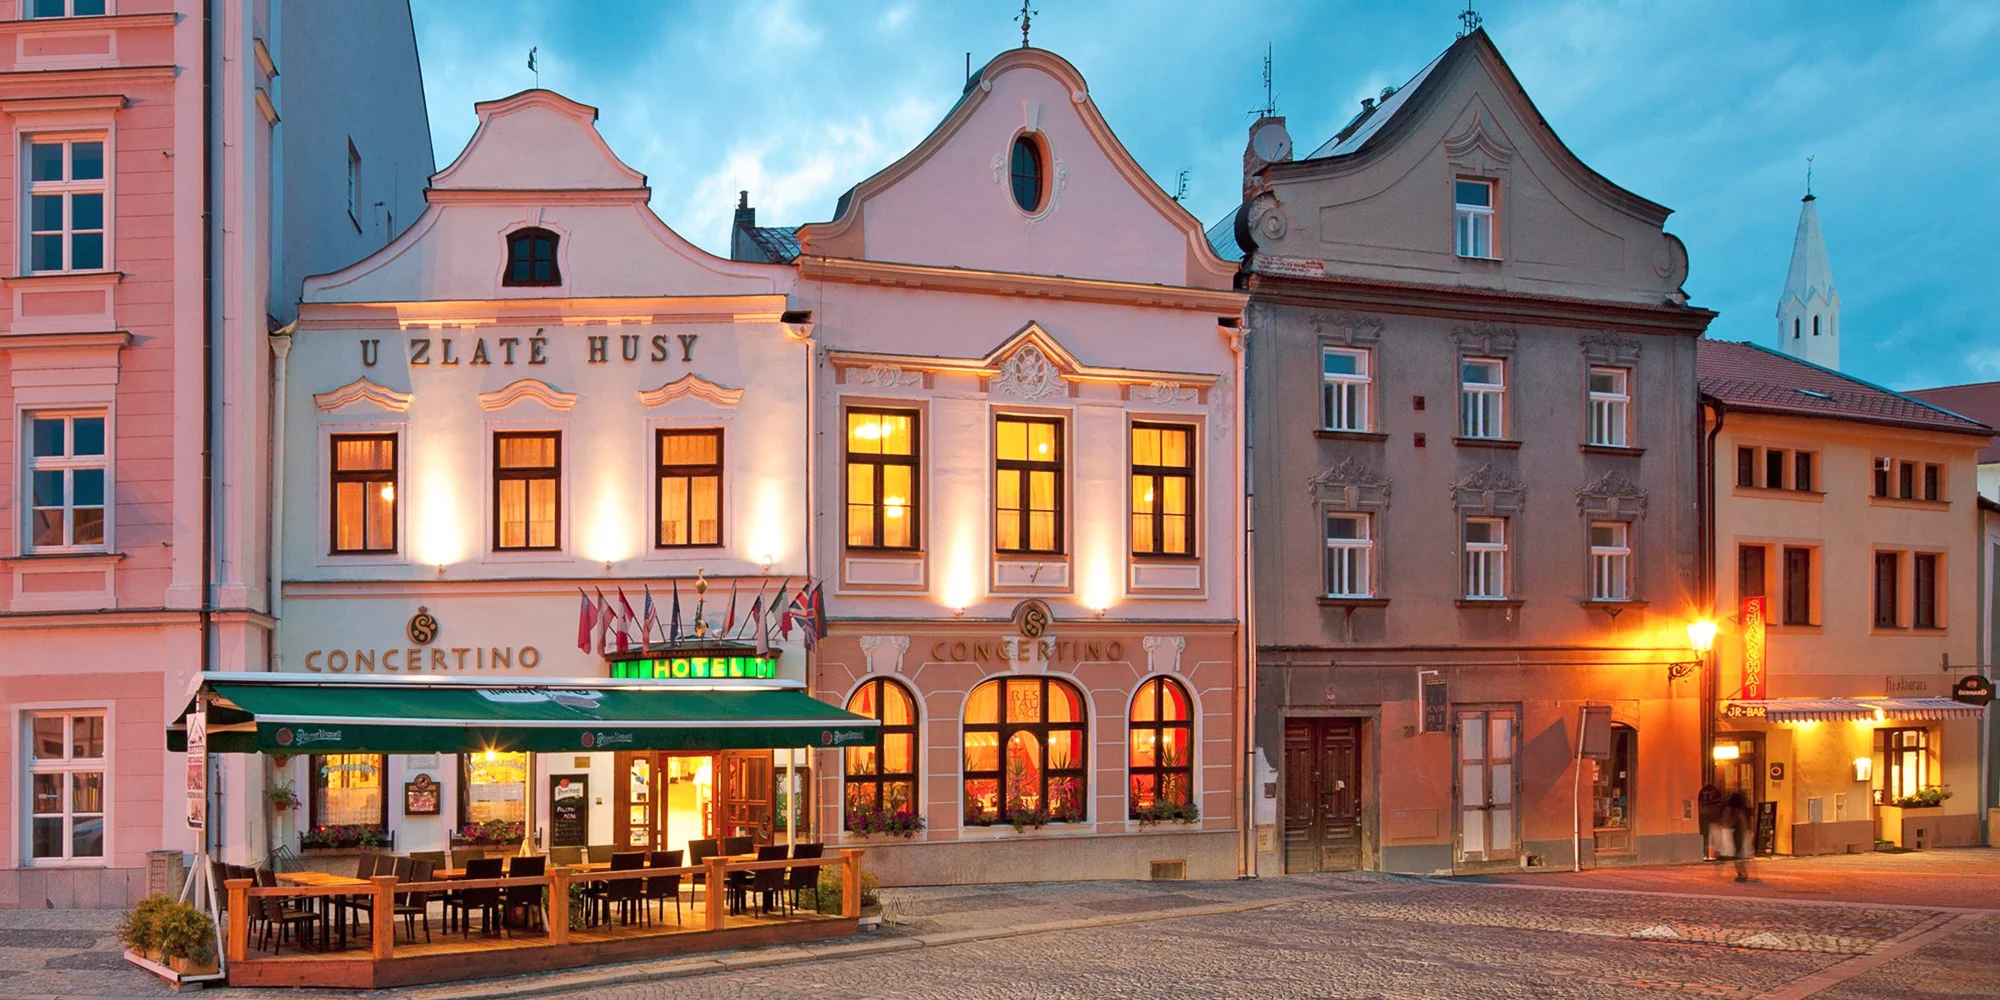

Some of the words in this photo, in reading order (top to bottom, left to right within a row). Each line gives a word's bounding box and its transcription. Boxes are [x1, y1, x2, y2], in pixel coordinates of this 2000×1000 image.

[360, 339, 379, 366] U
[410, 327, 548, 366] ZLATÉ
[588, 333, 699, 364] HUSY
[305, 645, 540, 673] CONCERTINO
[931, 639, 1125, 662] CONCERTINO
[1745, 599, 1760, 697] SHANGHAI
[653, 657, 742, 679] HOTEL
[1958, 688, 1988, 696] BERNARD
